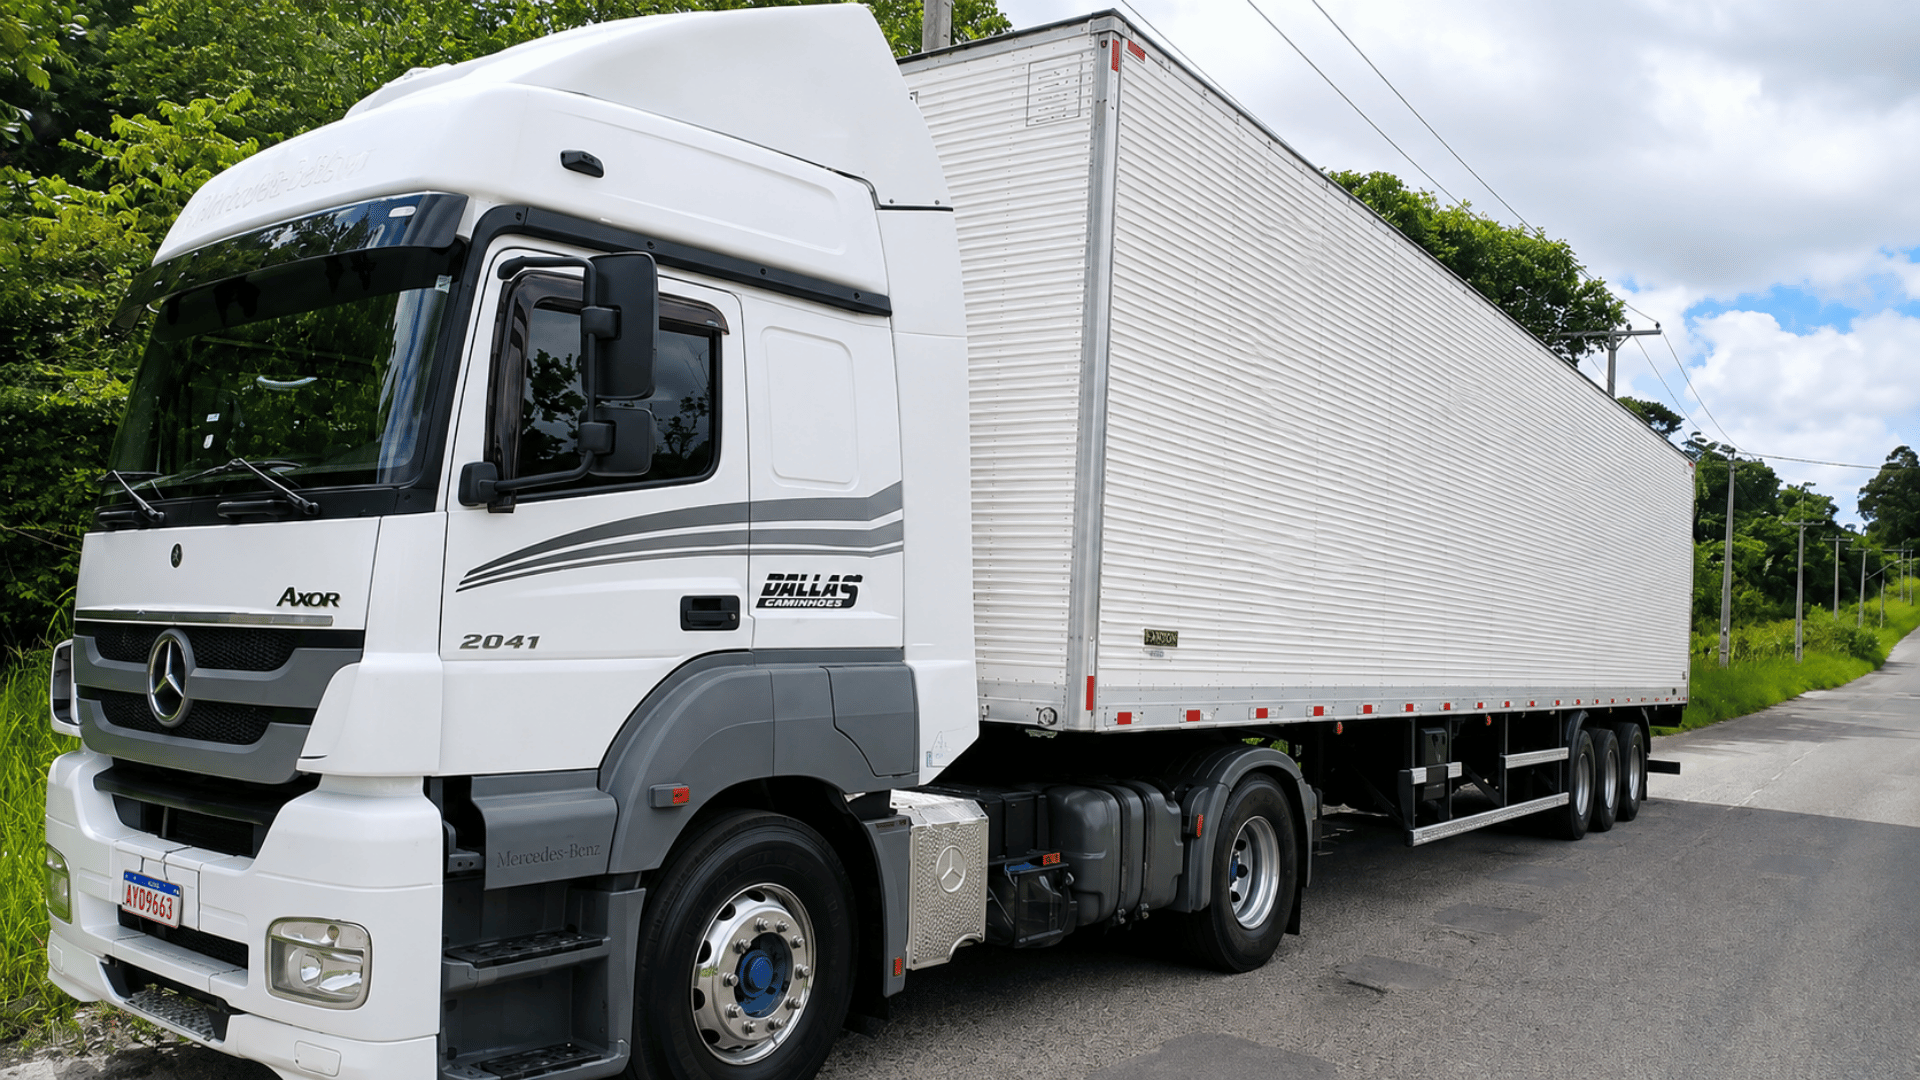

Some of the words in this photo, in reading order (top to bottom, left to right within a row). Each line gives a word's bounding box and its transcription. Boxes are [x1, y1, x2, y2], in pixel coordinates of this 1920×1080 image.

[761, 573, 863, 602] DALLAS
[459, 634, 540, 649] 2041
[497, 843, 600, 868] Mercedes-Benz
[126, 884, 172, 920] AYD9663
